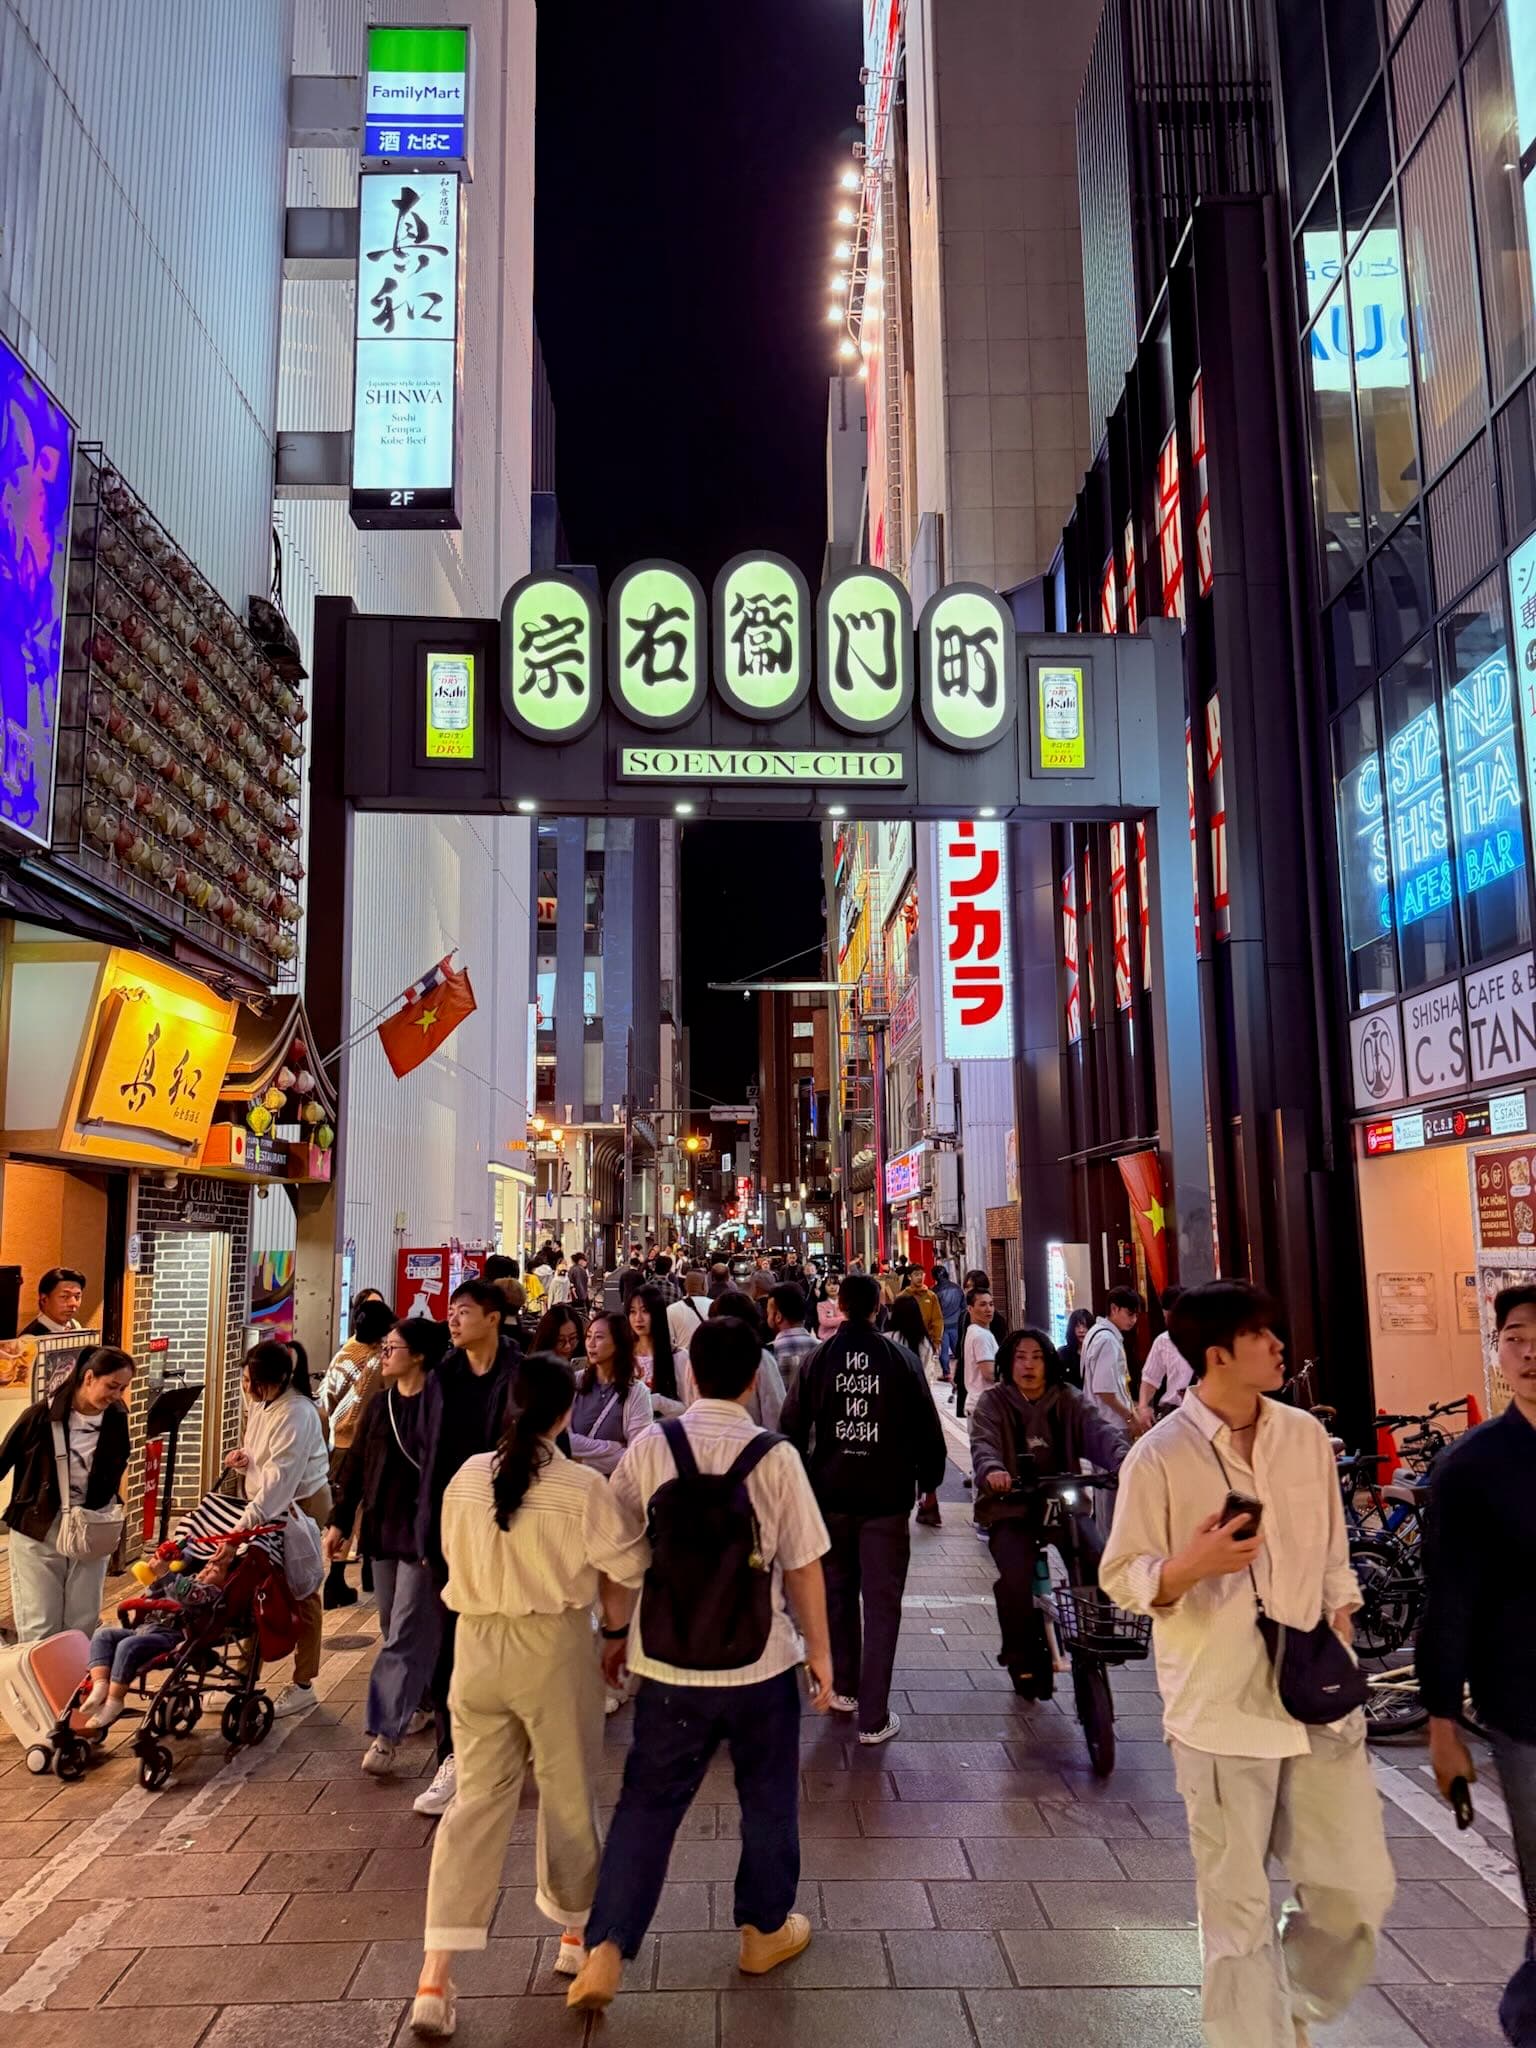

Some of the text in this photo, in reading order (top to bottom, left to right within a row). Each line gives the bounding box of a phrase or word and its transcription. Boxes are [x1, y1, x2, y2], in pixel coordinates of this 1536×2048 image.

[373, 86, 460, 101] FamilyMart
[379, 131, 451, 152] 酒 たばこ
[366, 389, 443, 404] SHINWA
[392, 413, 416, 422] Sushi
[381, 436, 426, 445] Kobe Beef
[390, 491, 415, 506] 2F
[434, 685, 466, 698] Asahi
[1046, 697, 1076, 709] Asahi
[629, 751, 896, 777] SOEMON-CHO
[1373, 745, 1521, 883] SHISHA
[1465, 829, 1516, 894] BAR
[948, 821, 1004, 1026] ンカラ
[1412, 992, 1461, 1030] SHISHA
[1467, 975, 1506, 1010] CAFE
[1512, 969, 1524, 996] &
